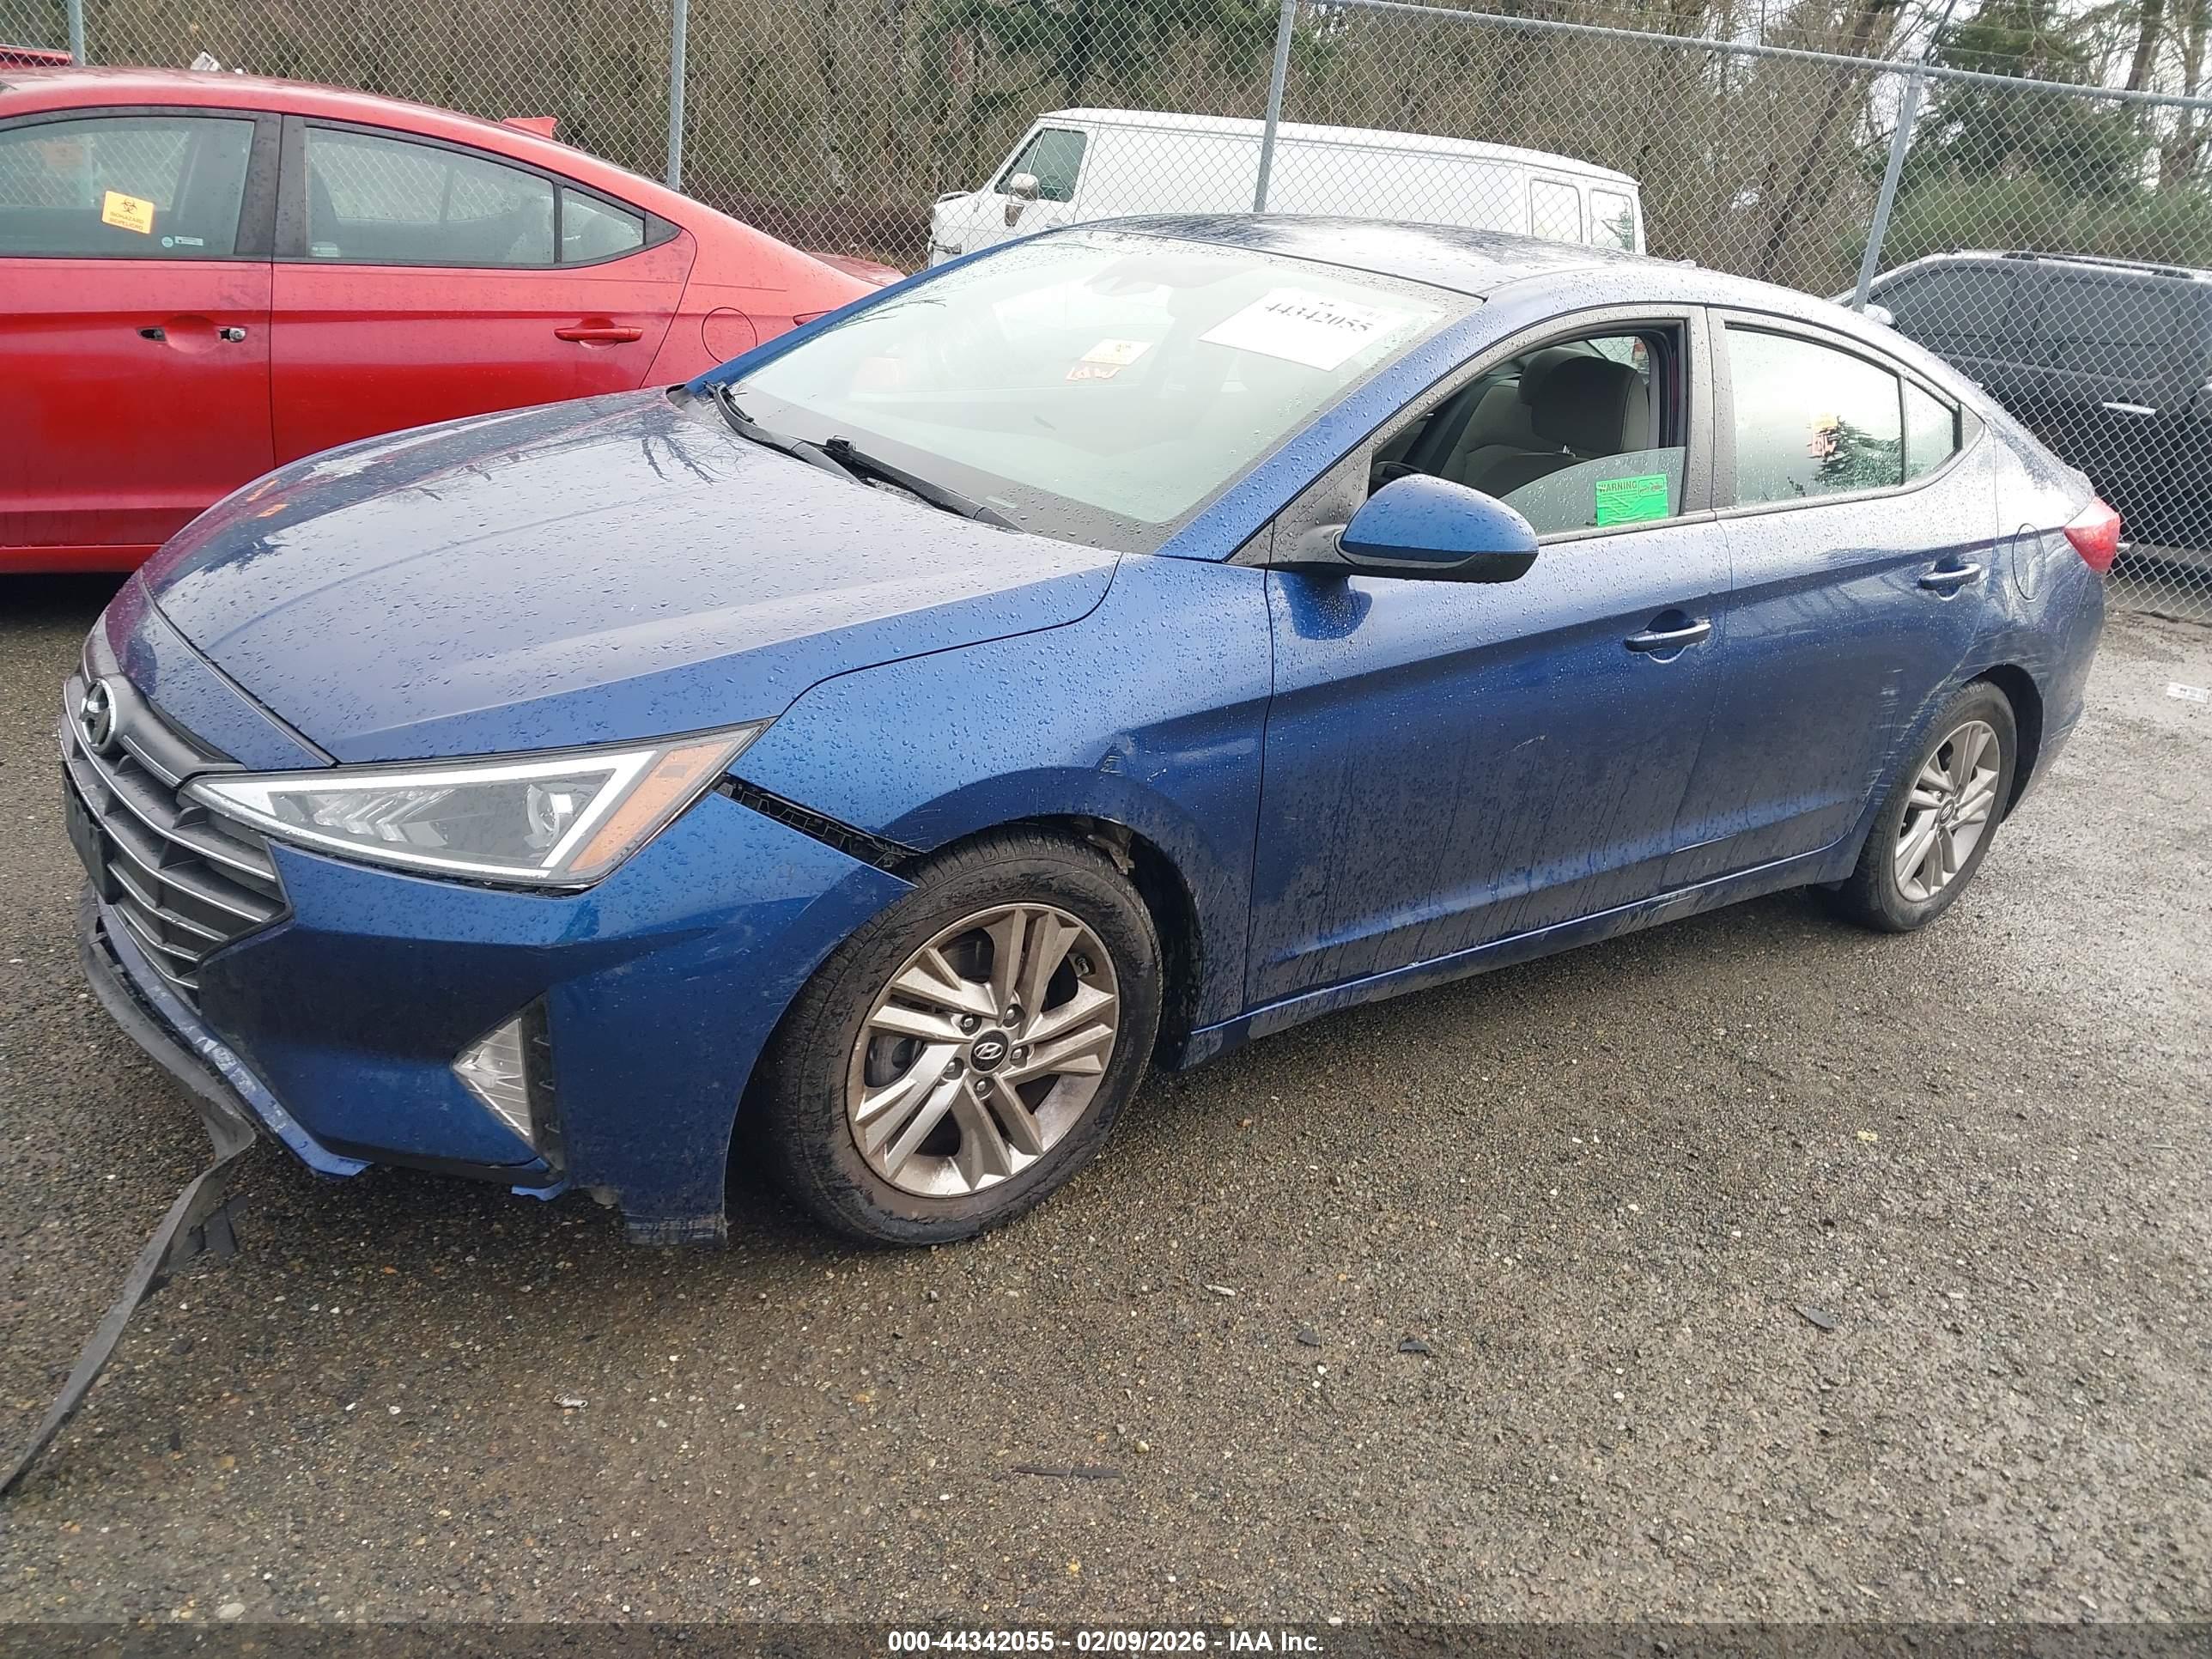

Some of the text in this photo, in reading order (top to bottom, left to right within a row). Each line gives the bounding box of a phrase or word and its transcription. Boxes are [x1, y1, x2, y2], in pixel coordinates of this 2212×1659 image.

[110, 211, 145, 224] BIOHAZARD
[1264, 302, 1375, 332] 44342055
[1599, 481, 1638, 493] WARNING
